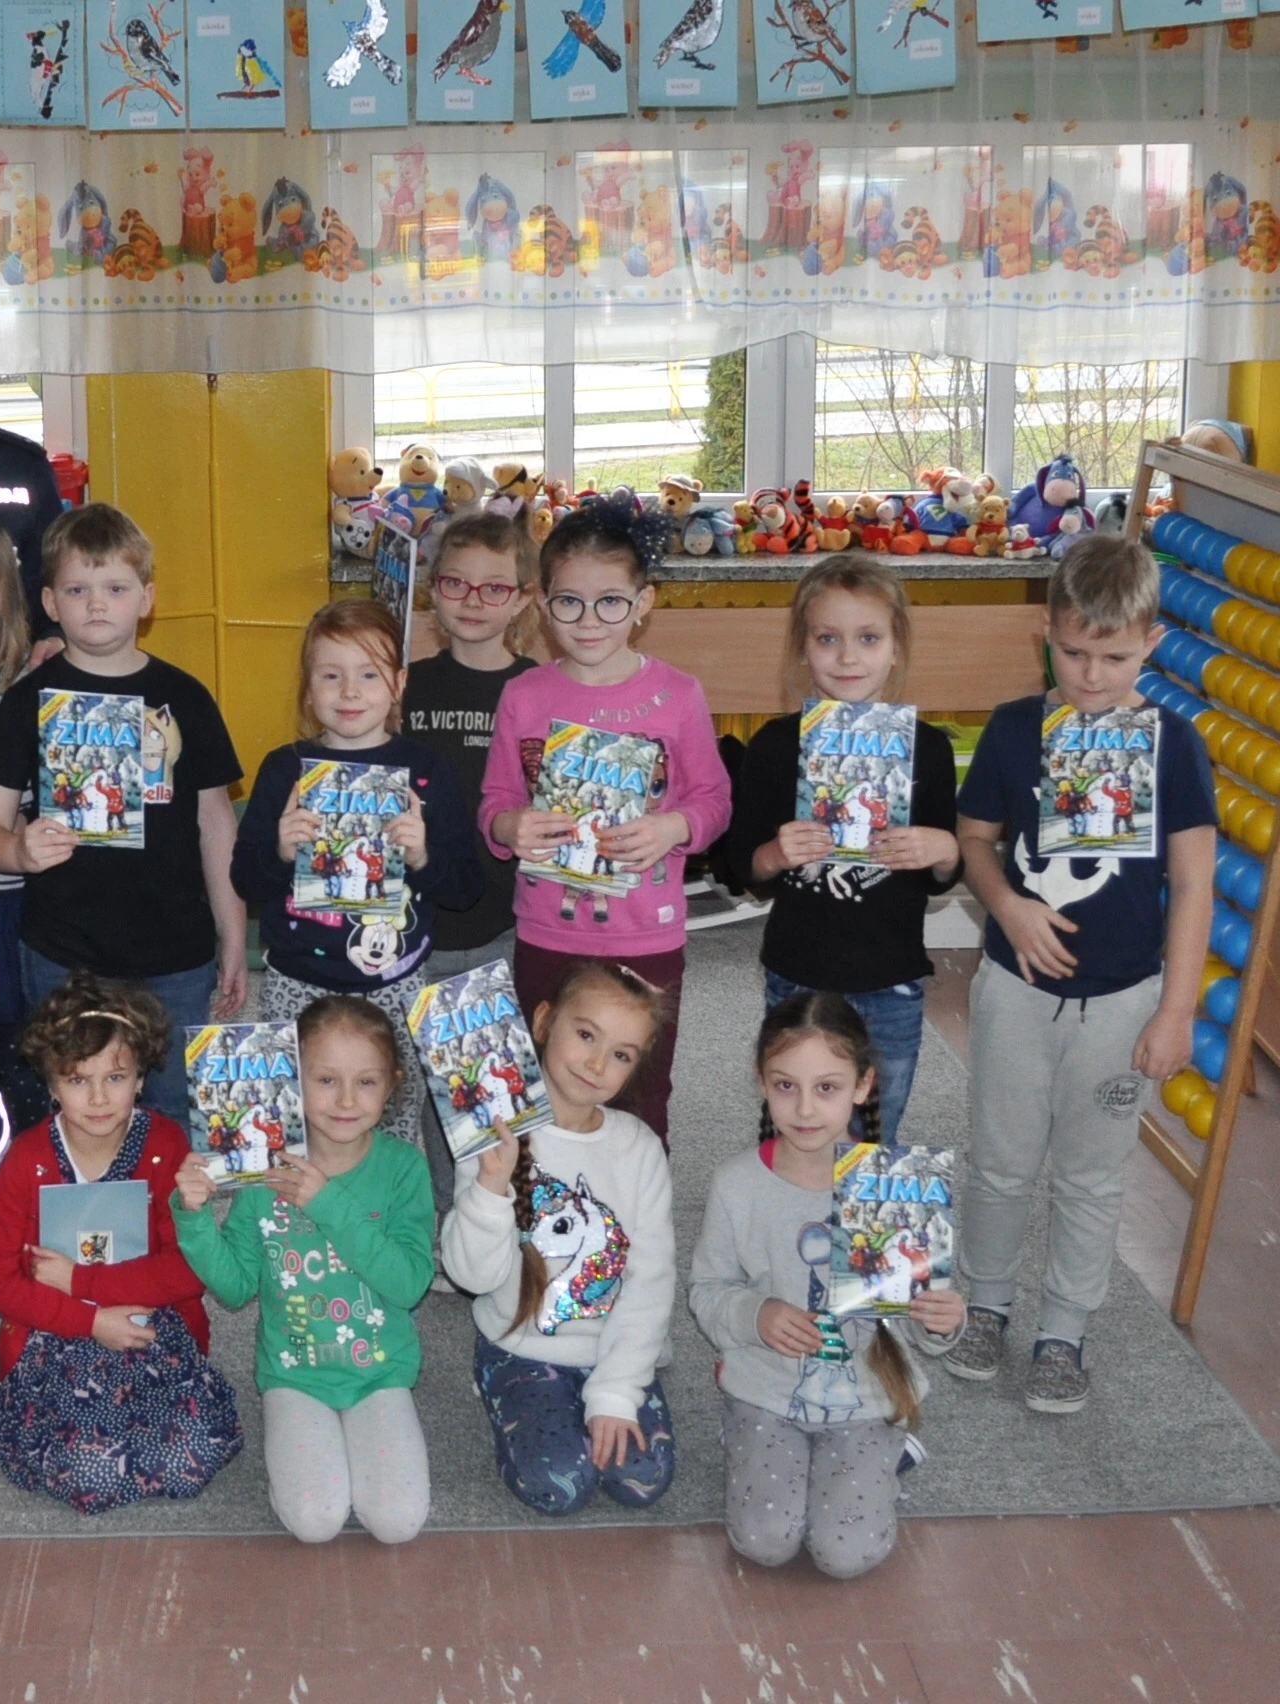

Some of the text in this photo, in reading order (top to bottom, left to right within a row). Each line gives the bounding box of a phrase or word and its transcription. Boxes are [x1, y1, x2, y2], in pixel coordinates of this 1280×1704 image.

[57, 718, 136, 747] ZIMA
[464, 735, 492, 748] LONDO
[820, 728, 907, 758] ZIMA
[1062, 727, 1149, 751] ZIMA
[562, 752, 644, 793] ZIMA
[319, 789, 400, 815] ZIMA
[430, 993, 515, 1044] ZIMA
[207, 1054, 293, 1081] ZIMA
[856, 1172, 950, 1204] ZIMA
